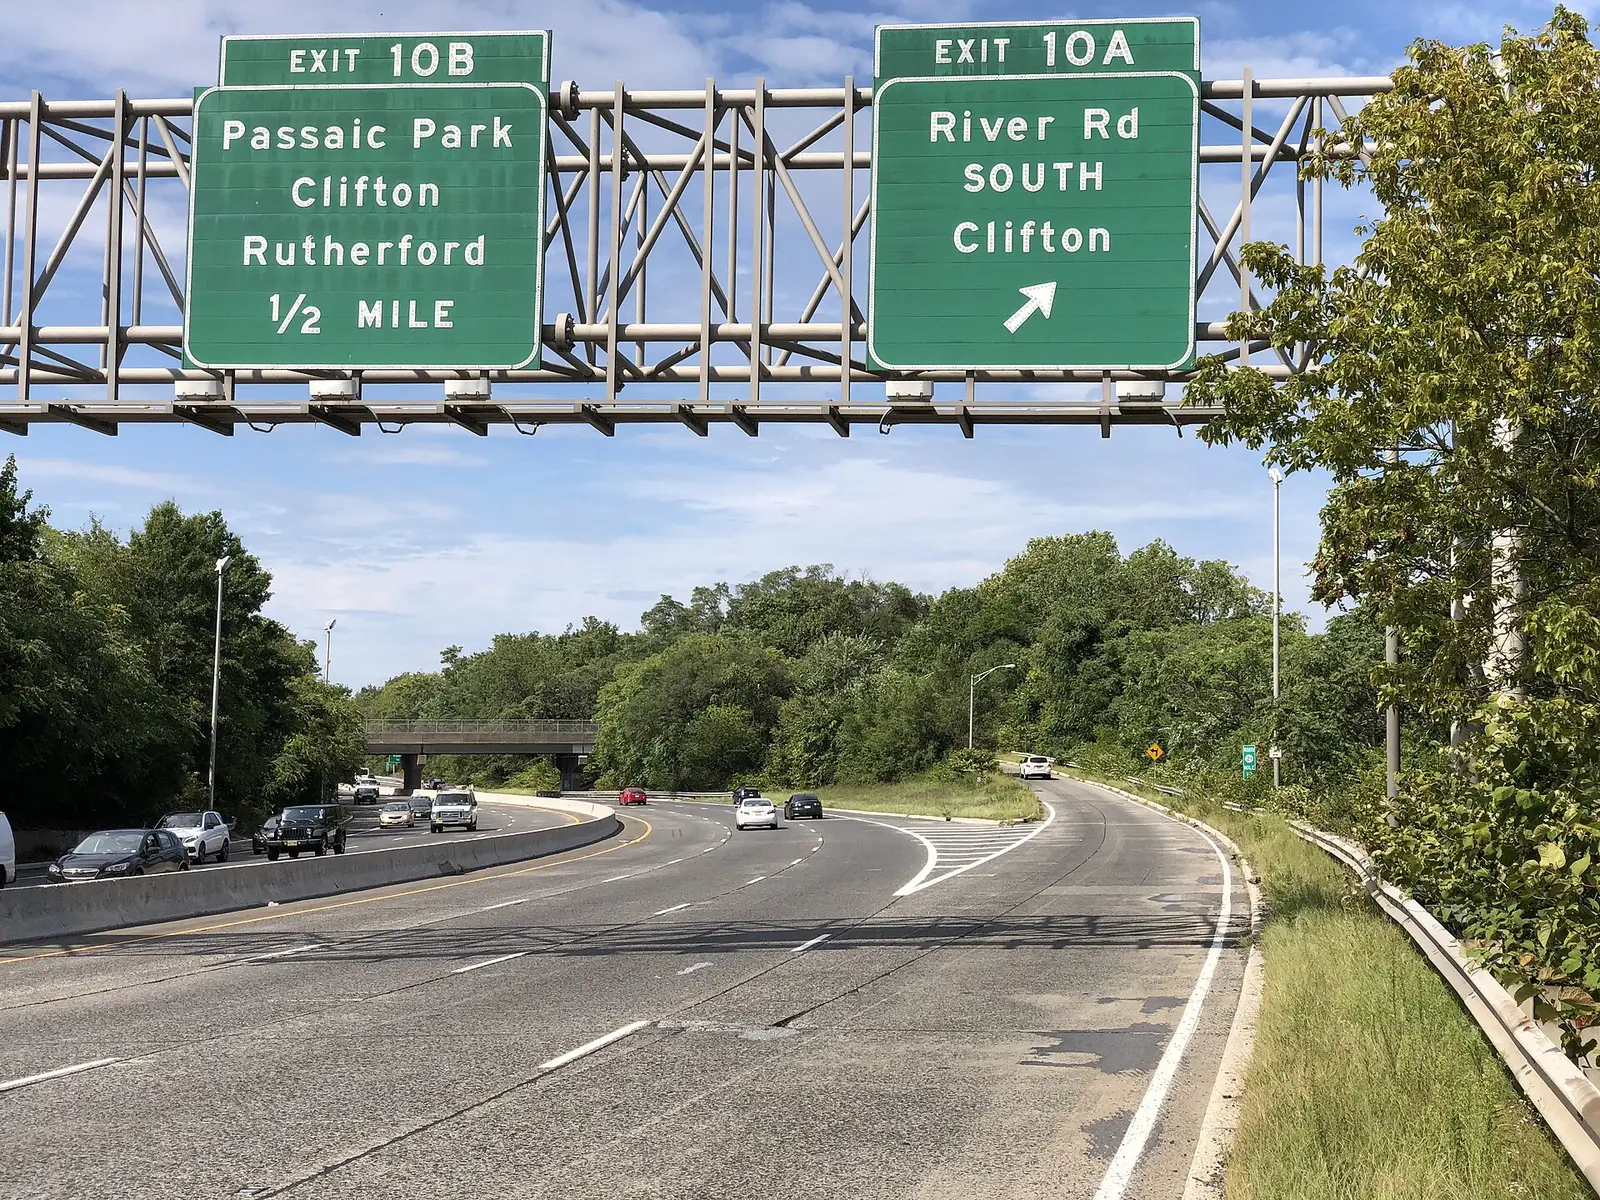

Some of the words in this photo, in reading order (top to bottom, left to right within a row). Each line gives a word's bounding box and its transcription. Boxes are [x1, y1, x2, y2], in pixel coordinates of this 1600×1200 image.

[289, 48, 361, 73] EXIT
[390, 42, 475, 77] 10B
[935, 38, 1011, 64] EXIT
[1042, 29, 1135, 67] 10A
[222, 117, 387, 150] Passaic
[413, 116, 514, 149] Park
[930, 109, 1055, 143] River
[1083, 106, 1140, 140] Rd
[291, 175, 440, 208] Clifton
[963, 161, 1104, 193] SOUTH
[243, 233, 485, 266] Rutherford
[953, 220, 1111, 254] Clifton
[269, 293, 322, 334] 1/2
[357, 300, 455, 328] MILE
